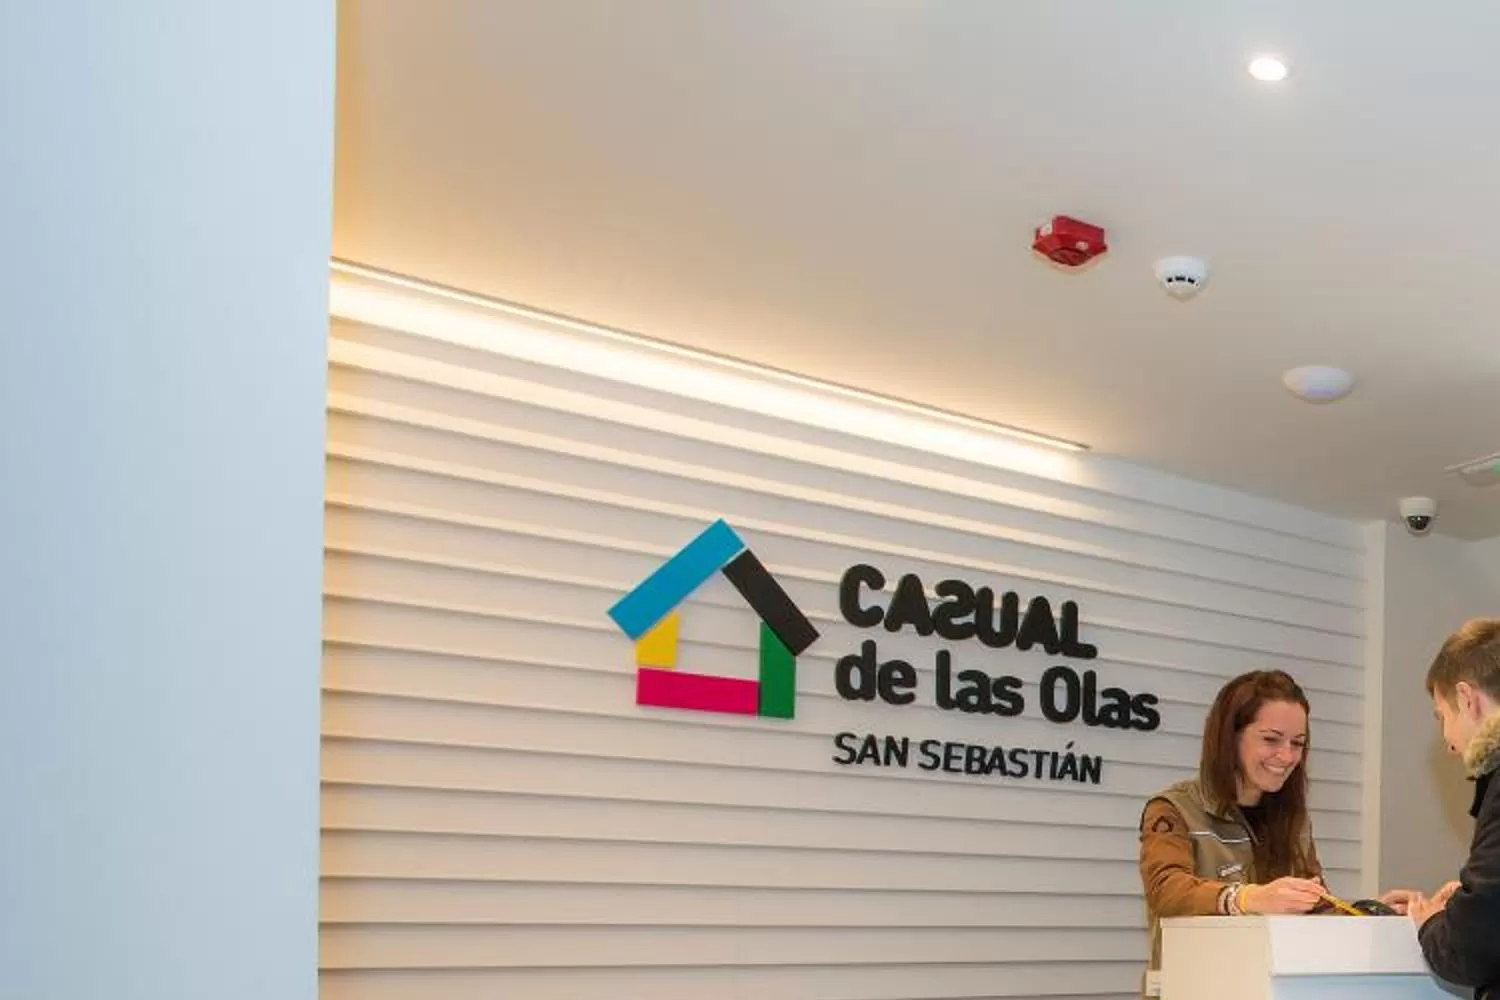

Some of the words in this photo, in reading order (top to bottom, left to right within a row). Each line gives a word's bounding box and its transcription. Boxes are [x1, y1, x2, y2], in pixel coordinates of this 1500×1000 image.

[838, 563, 1099, 661] CASUAL
[834, 638, 918, 706] de
[934, 648, 1026, 718] las
[1038, 664, 1162, 732] Olas
[832, 731, 910, 769] SAN
[916, 738, 1104, 786] SEBASTIÁN
